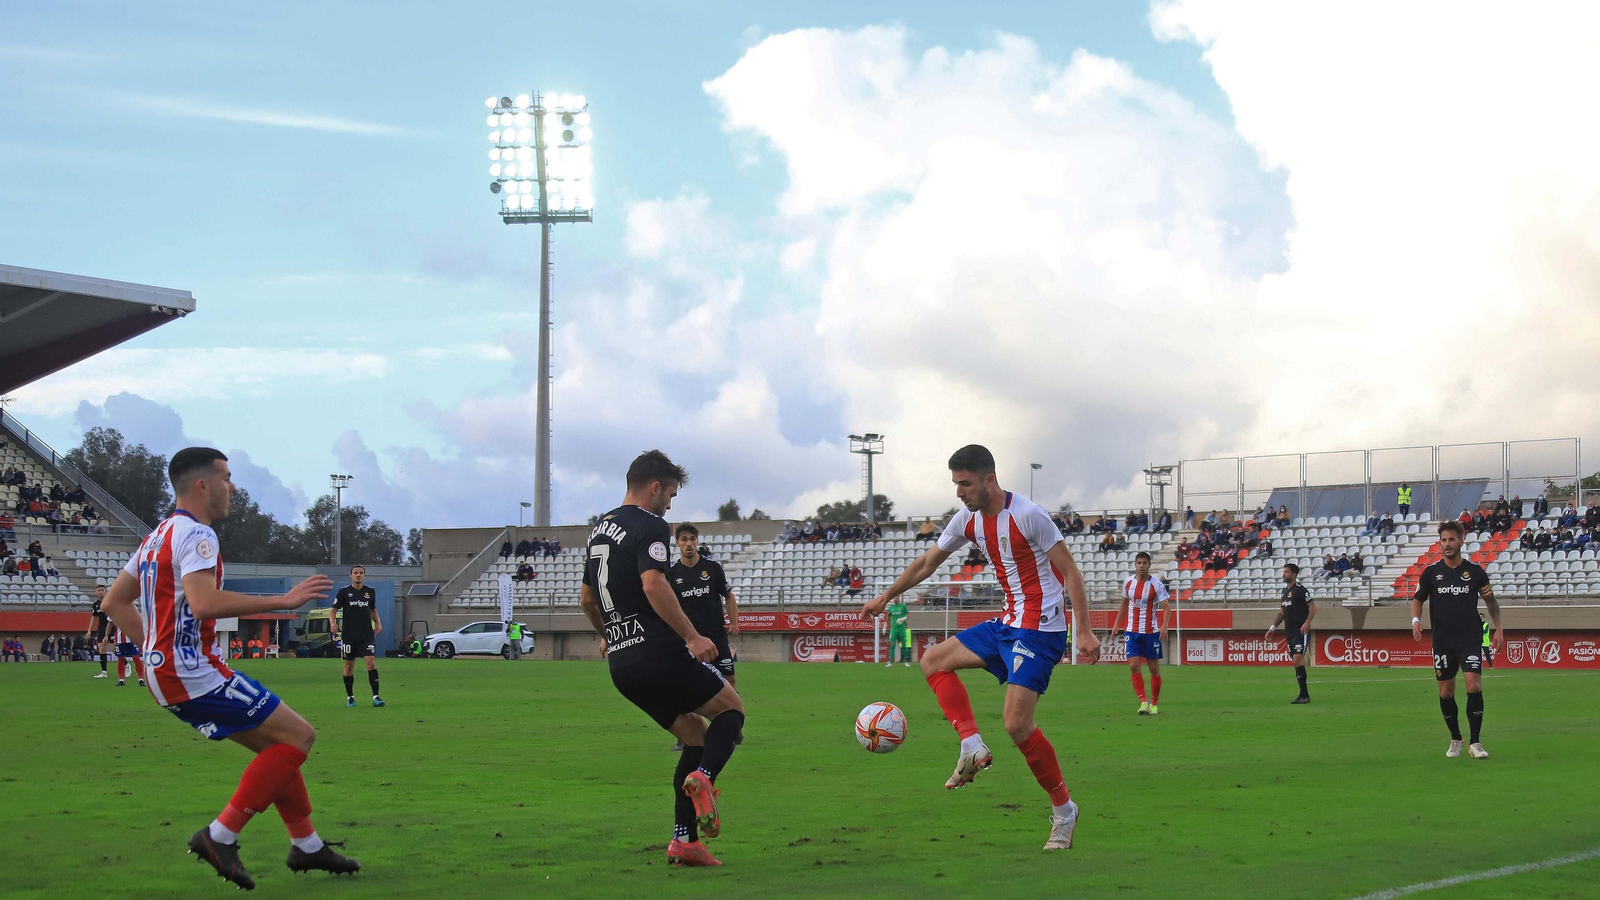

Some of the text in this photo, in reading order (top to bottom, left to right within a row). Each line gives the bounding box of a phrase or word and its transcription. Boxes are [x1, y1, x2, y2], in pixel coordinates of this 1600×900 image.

[590, 544, 615, 612] 7
[825, 613, 858, 621] CARTEYA
[825, 621, 845, 629] CAMPO
[846, 621, 854, 629] DE
[805, 635, 855, 647] CLEMENTE
[1228, 640, 1278, 651] Socialistas
[1344, 633, 1362, 649] de
[342, 644, 351, 653] 10
[1188, 649, 1204, 657] PSOE
[1324, 635, 1389, 662] Castro
[1568, 646, 1600, 655] PASIÓN
[1228, 652, 1245, 662] con
[1247, 651, 1256, 662] el
[1434, 654, 1448, 669] 21
[226, 674, 260, 706] 17
